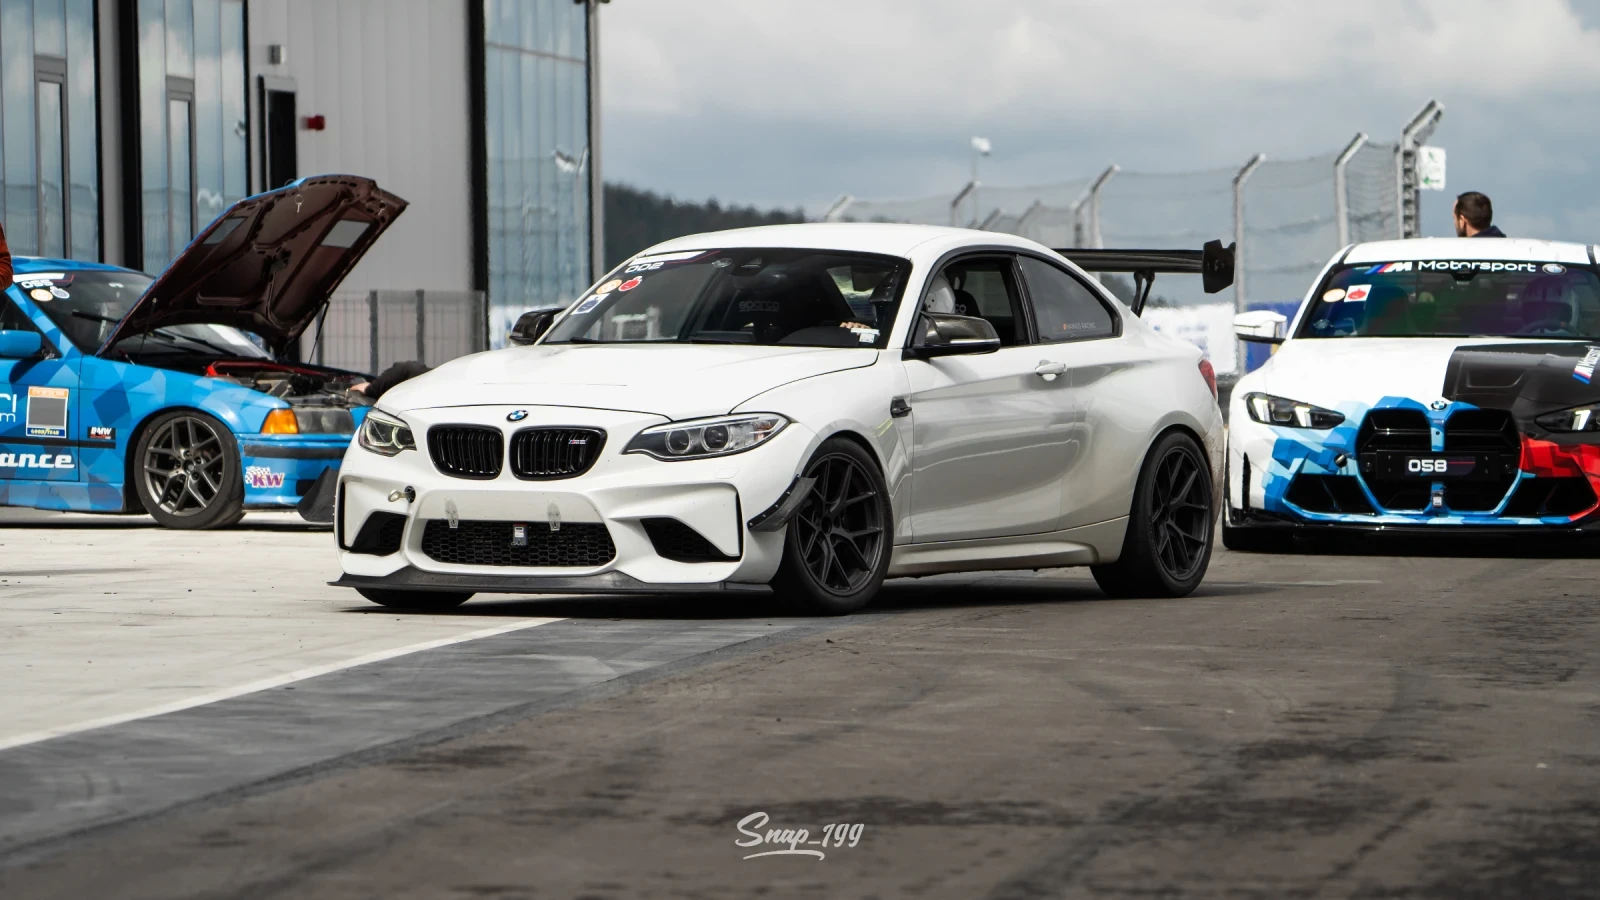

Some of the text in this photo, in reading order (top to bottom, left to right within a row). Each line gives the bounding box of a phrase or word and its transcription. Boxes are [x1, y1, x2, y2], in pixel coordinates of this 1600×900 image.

[624, 261, 665, 274] 002
[1418, 261, 1536, 273] Motorsport
[90, 426, 112, 436] BMW
[0, 453, 75, 468] ance
[1408, 459, 1447, 472] 058
[252, 473, 285, 488] KW
